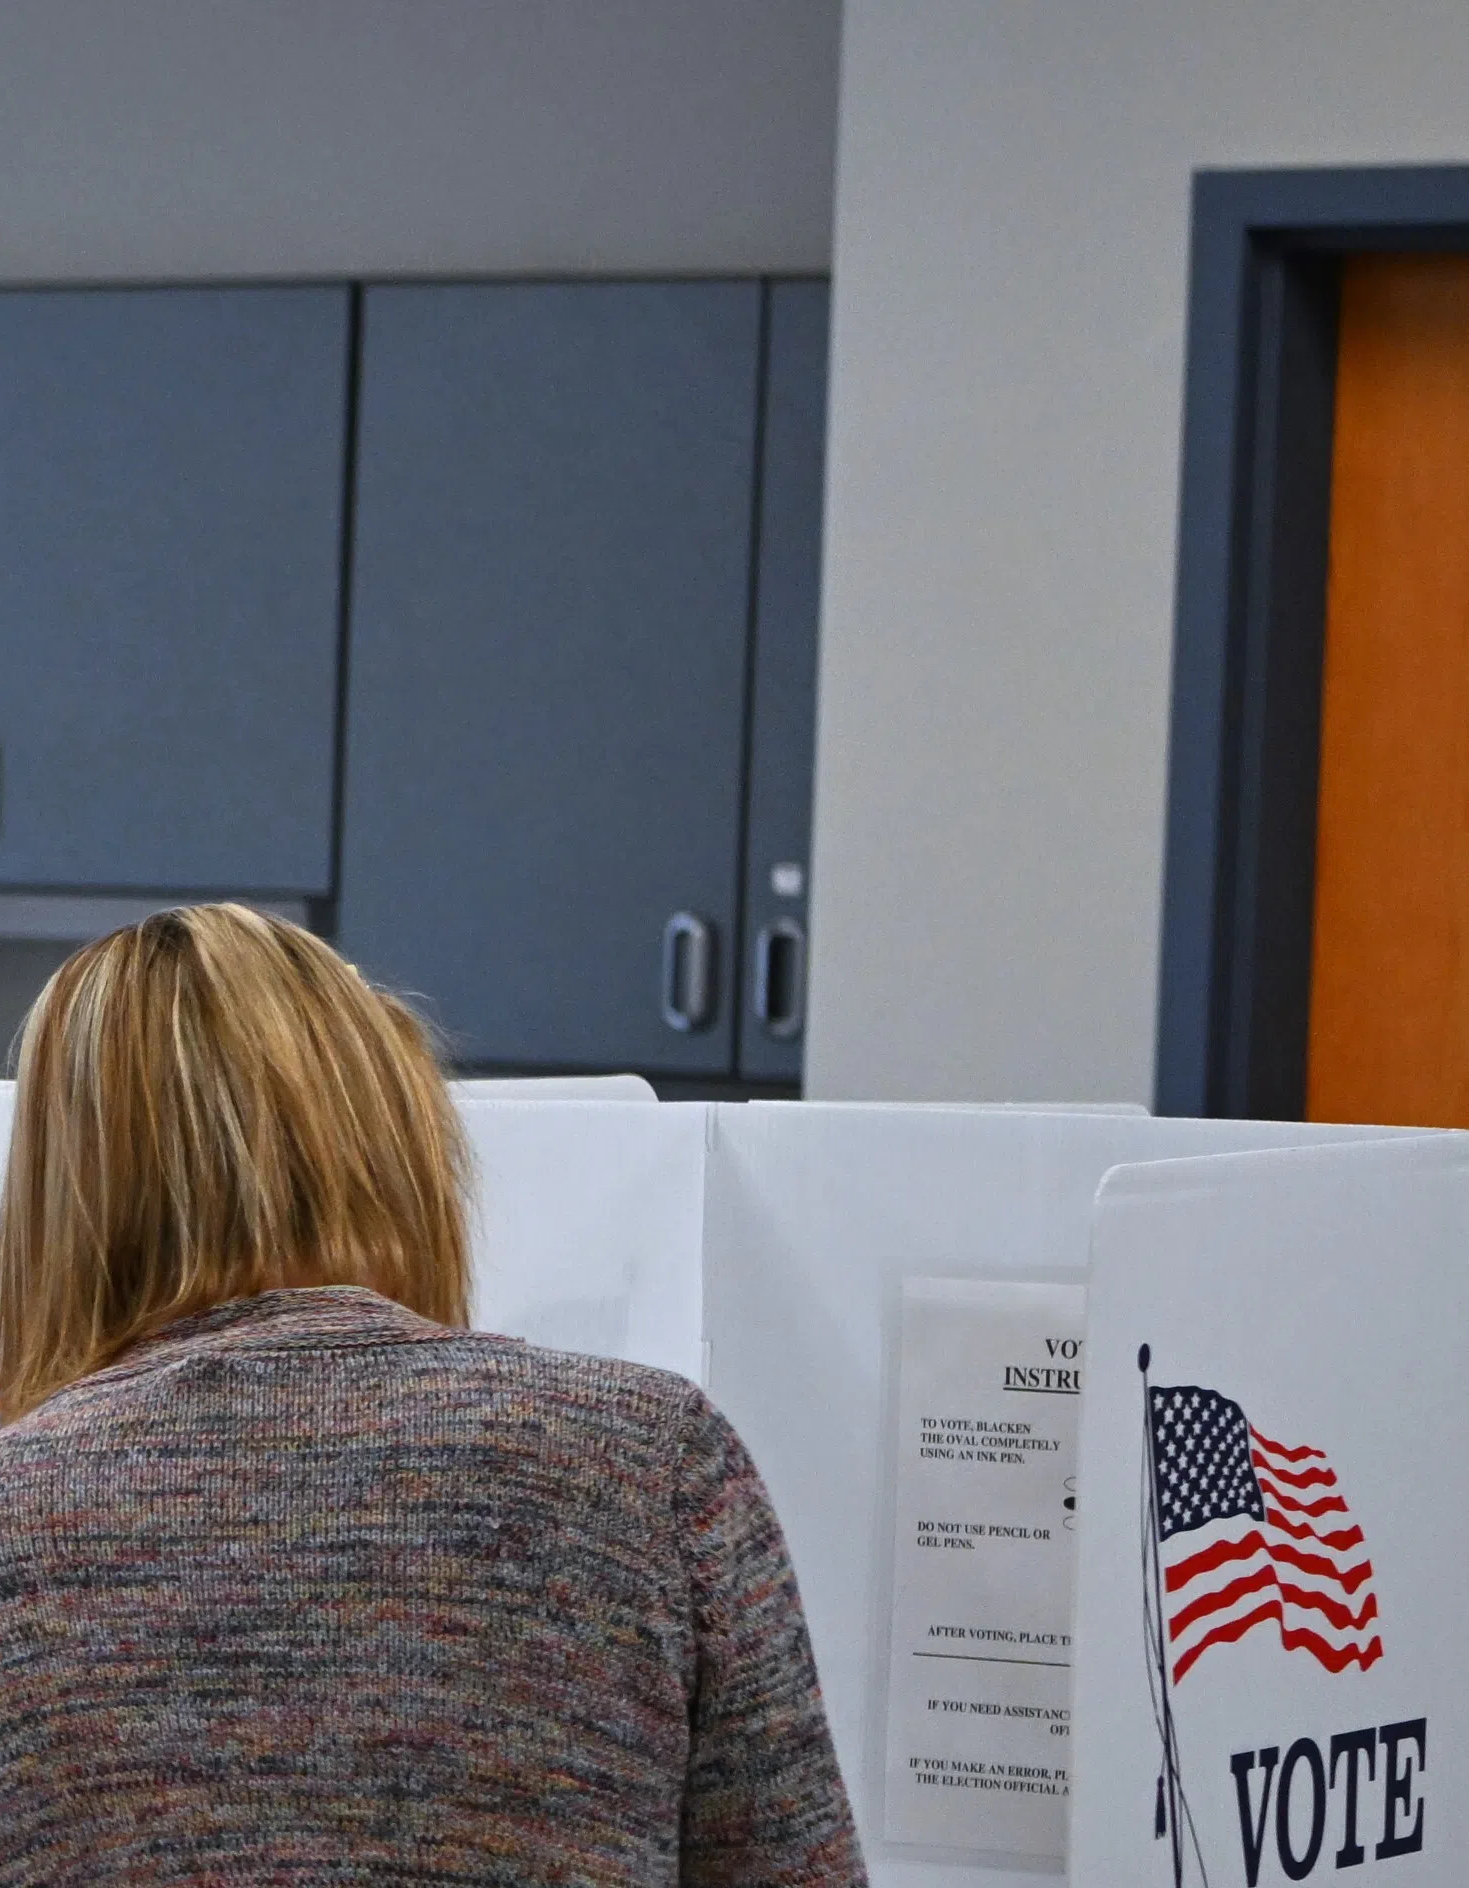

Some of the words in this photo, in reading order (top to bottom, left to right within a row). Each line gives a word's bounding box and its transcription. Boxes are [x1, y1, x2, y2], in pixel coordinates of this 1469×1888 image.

[1045, 1339, 1083, 1359] VO
[921, 1418, 937, 1429] TO
[940, 1419, 974, 1432] VOTE,
[977, 1421, 1031, 1434] BLACKEN
[921, 1433, 944, 1444] THE
[946, 1434, 979, 1446] OVAL
[981, 1436, 1061, 1452] COMPLETELY
[920, 1447, 955, 1460] USING
[958, 1450, 974, 1461] AN
[977, 1451, 997, 1462] INK
[1000, 1452, 1025, 1464] PEN.
[918, 1521, 934, 1532] DO
[938, 1522, 962, 1534] NOT
[965, 1524, 986, 1535] USE
[988, 1526, 1031, 1539] PENCIL
[1033, 1529, 1050, 1540] OR
[917, 1536, 941, 1547] GEL
[944, 1537, 975, 1549] PENS.
[928, 1625, 966, 1638] AFTER
[969, 1628, 1017, 1643] VOTING,
[1019, 1632, 1058, 1645] PLACE
[927, 1699, 939, 1710] IF
[943, 1701, 967, 1712] YOU
[970, 1703, 1001, 1715] NEED
[909, 1757, 921, 1768] IF
[924, 1759, 948, 1770] YOU
[951, 1761, 985, 1774] MAKE
[989, 1764, 1005, 1775] AN
[1008, 1766, 1051, 1780] ERROR,
[915, 1773, 939, 1785] THE
[942, 1776, 1001, 1790] ELECTION
[1004, 1780, 1059, 1795] OFFICIAL
[1230, 1717, 1427, 1888] VOTE
